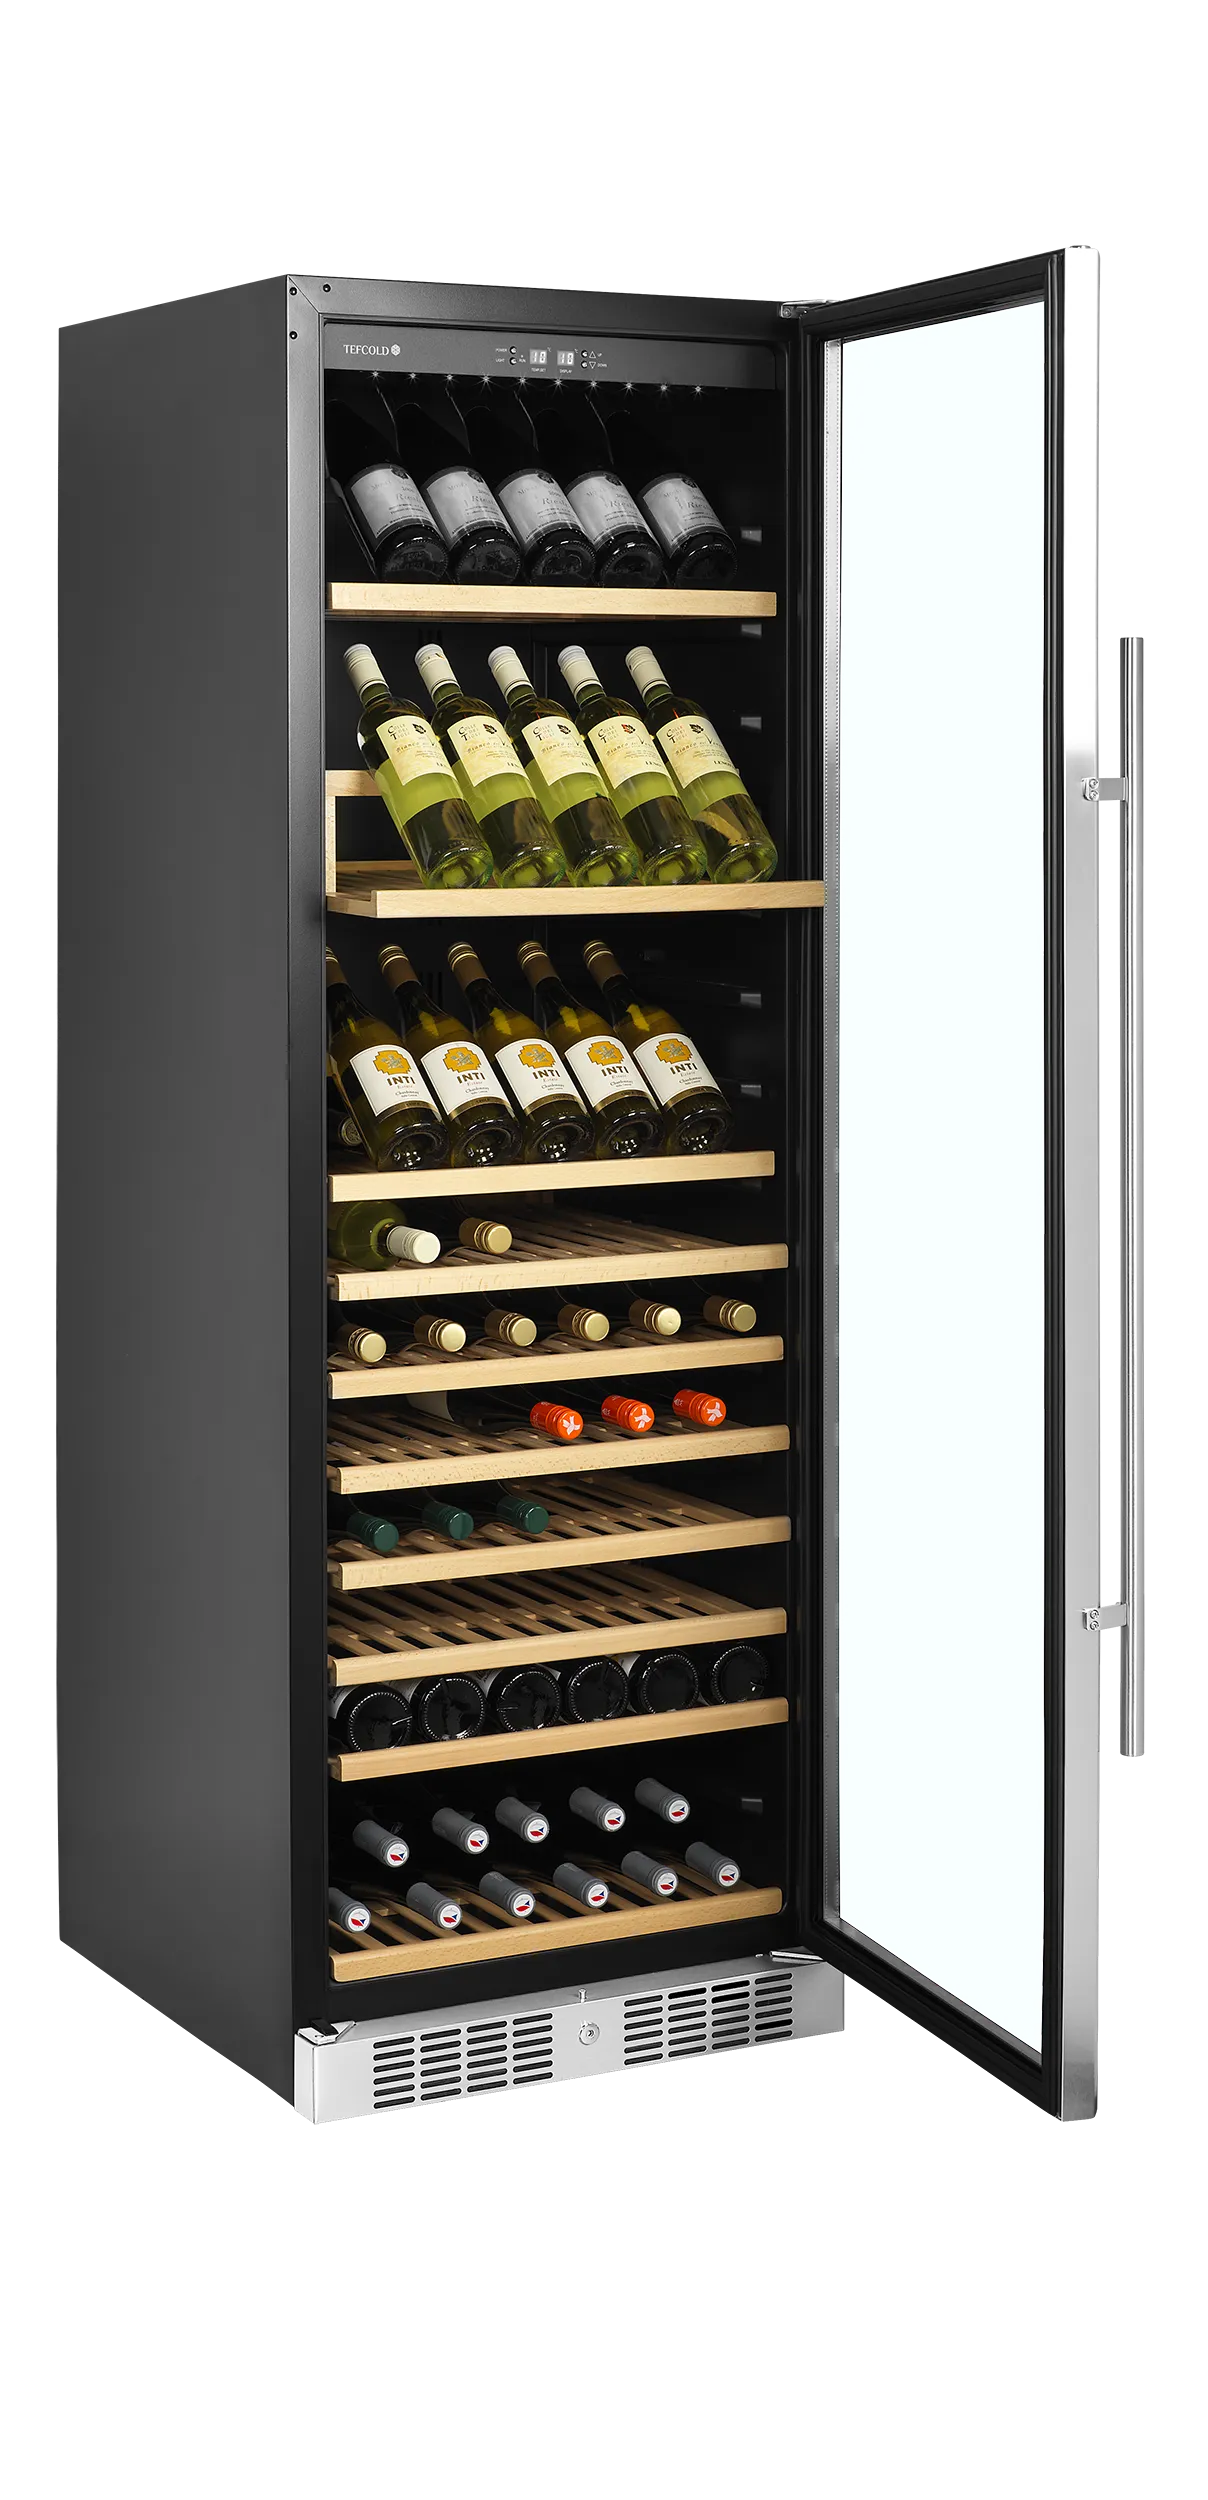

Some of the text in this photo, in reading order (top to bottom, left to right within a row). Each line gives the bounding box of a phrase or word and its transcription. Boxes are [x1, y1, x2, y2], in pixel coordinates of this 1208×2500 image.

[343, 344, 389, 356] TEFCOLD
[532, 1069, 561, 1080] INTI
[601, 1065, 629, 1077] INTI
[670, 1062, 698, 1075] INTI
[387, 1075, 415, 1086] INTI
[457, 1072, 486, 1084] INTI
